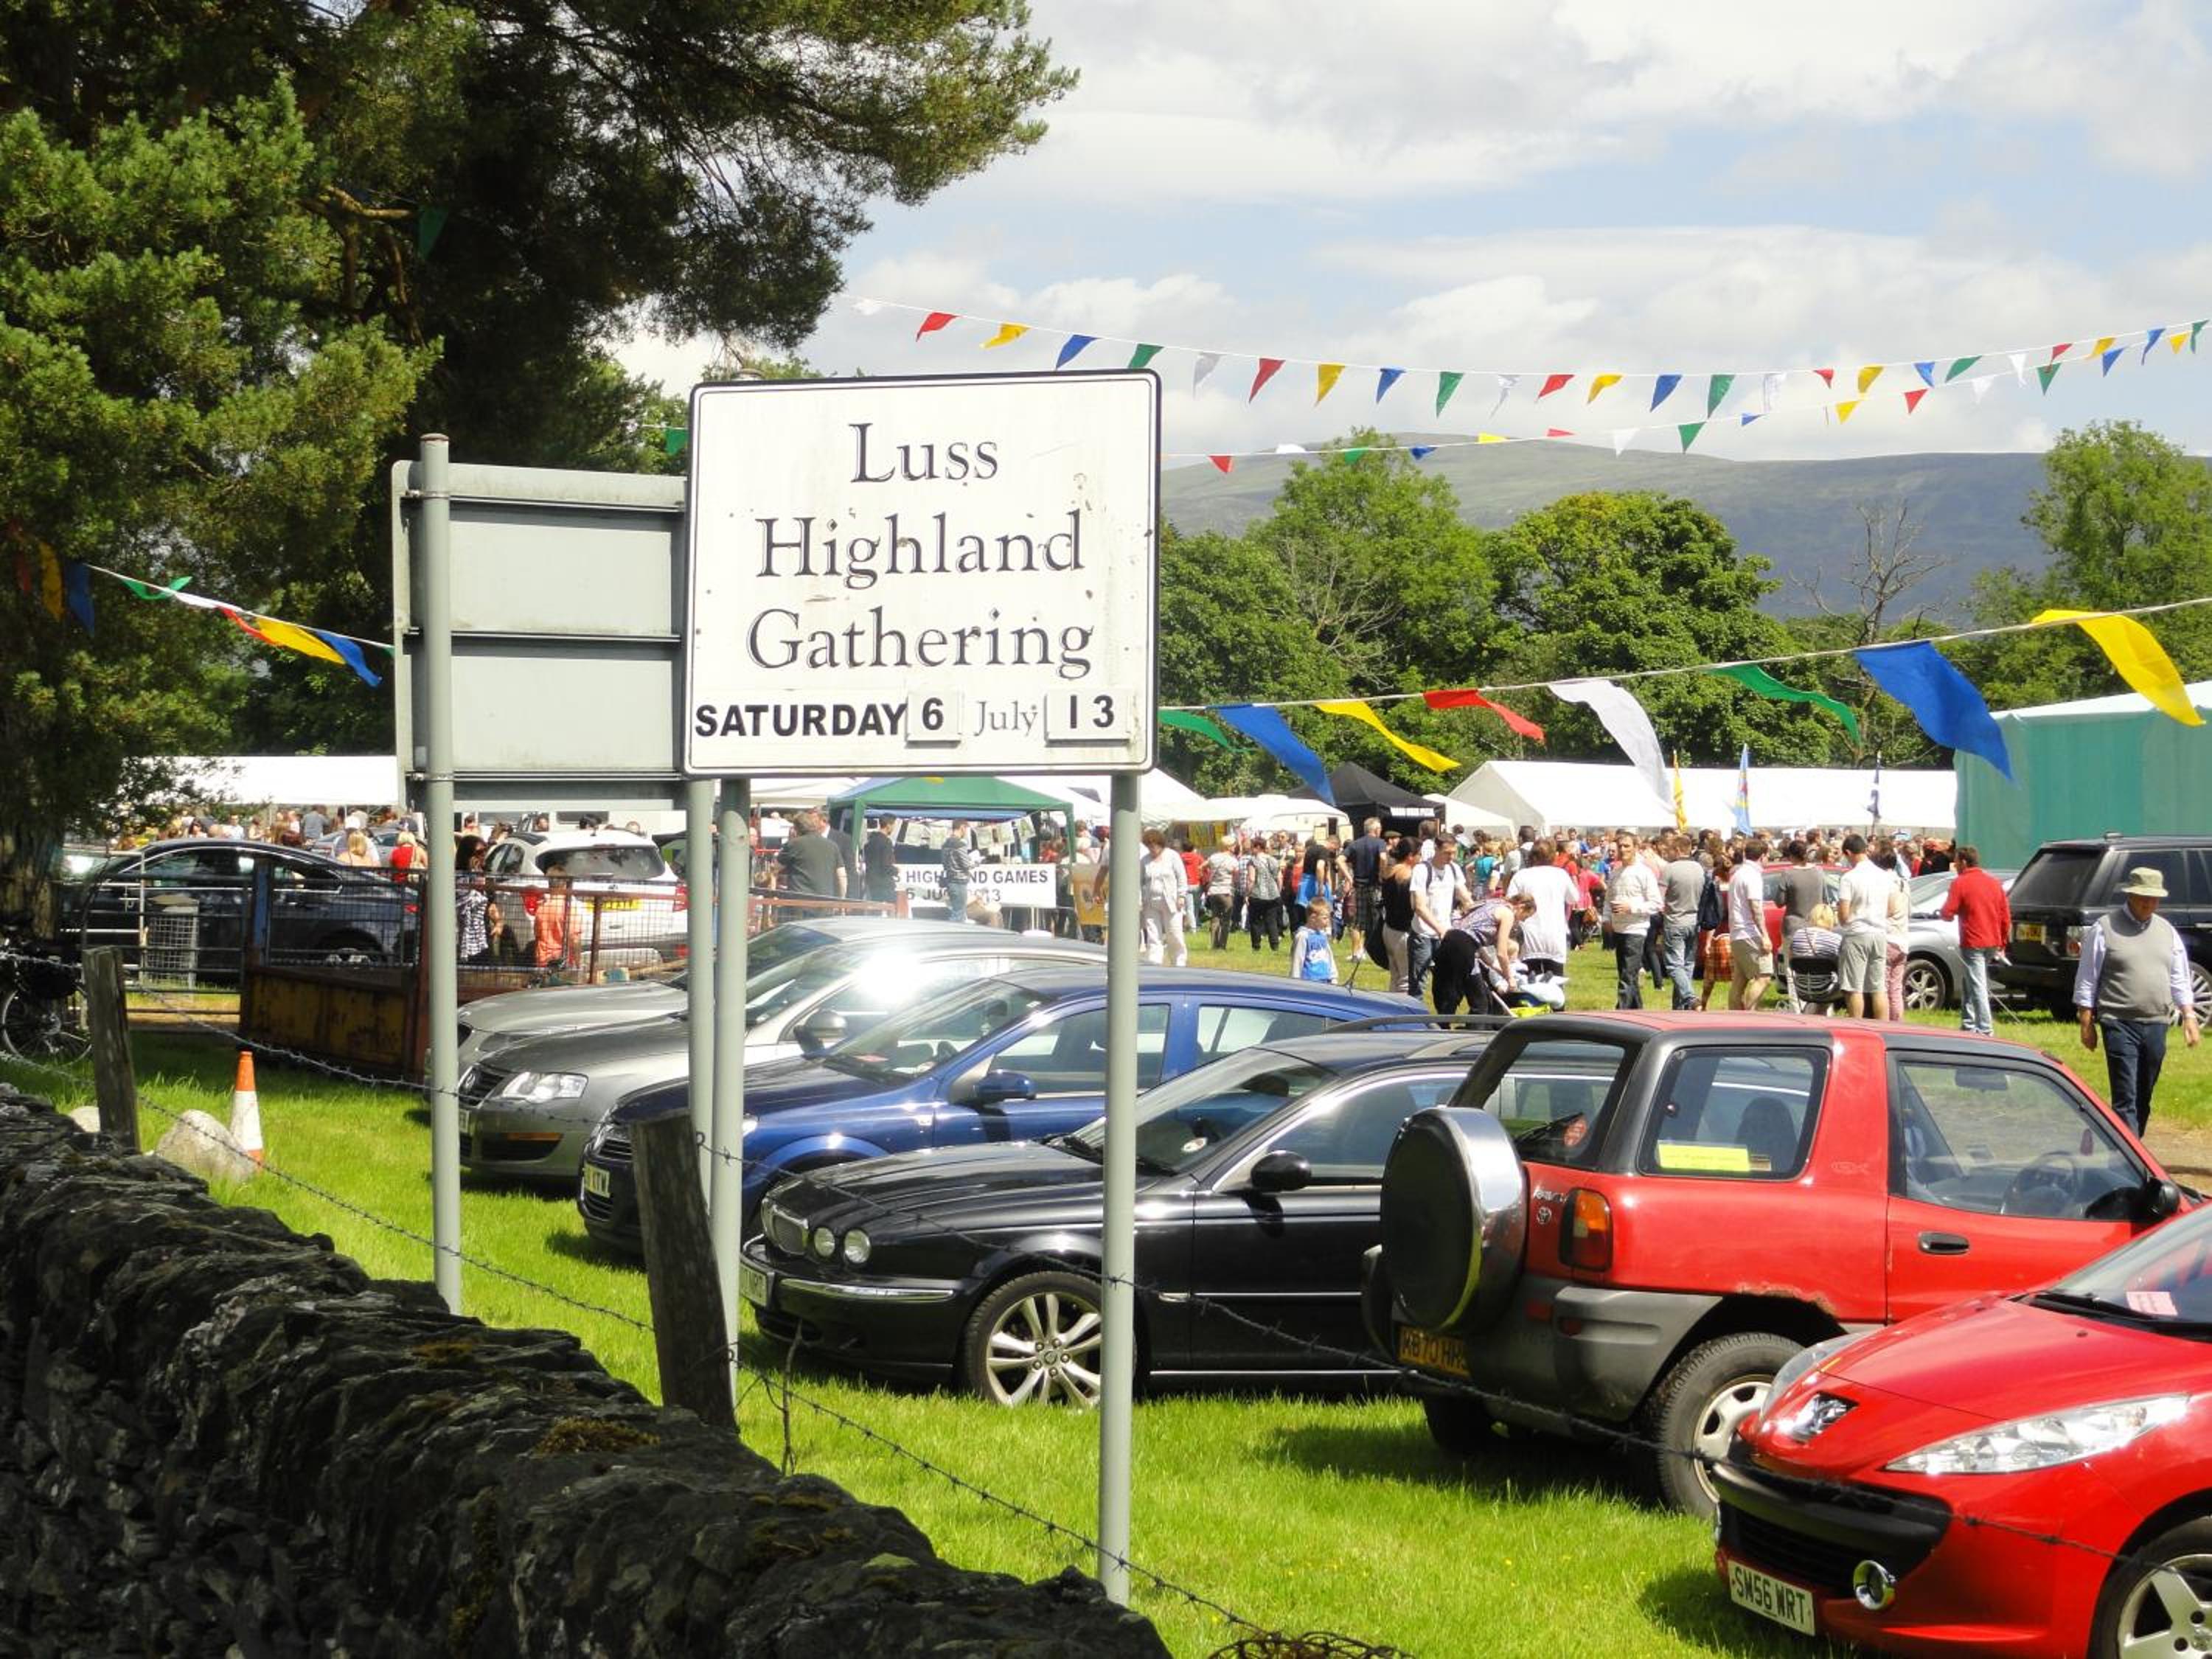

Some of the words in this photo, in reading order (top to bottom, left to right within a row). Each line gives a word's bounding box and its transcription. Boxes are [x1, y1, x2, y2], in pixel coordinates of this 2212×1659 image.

[848, 422, 998, 483] Luss
[756, 509, 1085, 590] Highland
[748, 606, 1094, 680] Gathering
[695, 703, 908, 737] SATURDAY
[922, 697, 944, 730] 6
[974, 700, 1038, 737] July
[906, 870, 988, 883] HIGHND
[993, 870, 1048, 884] GAMES
